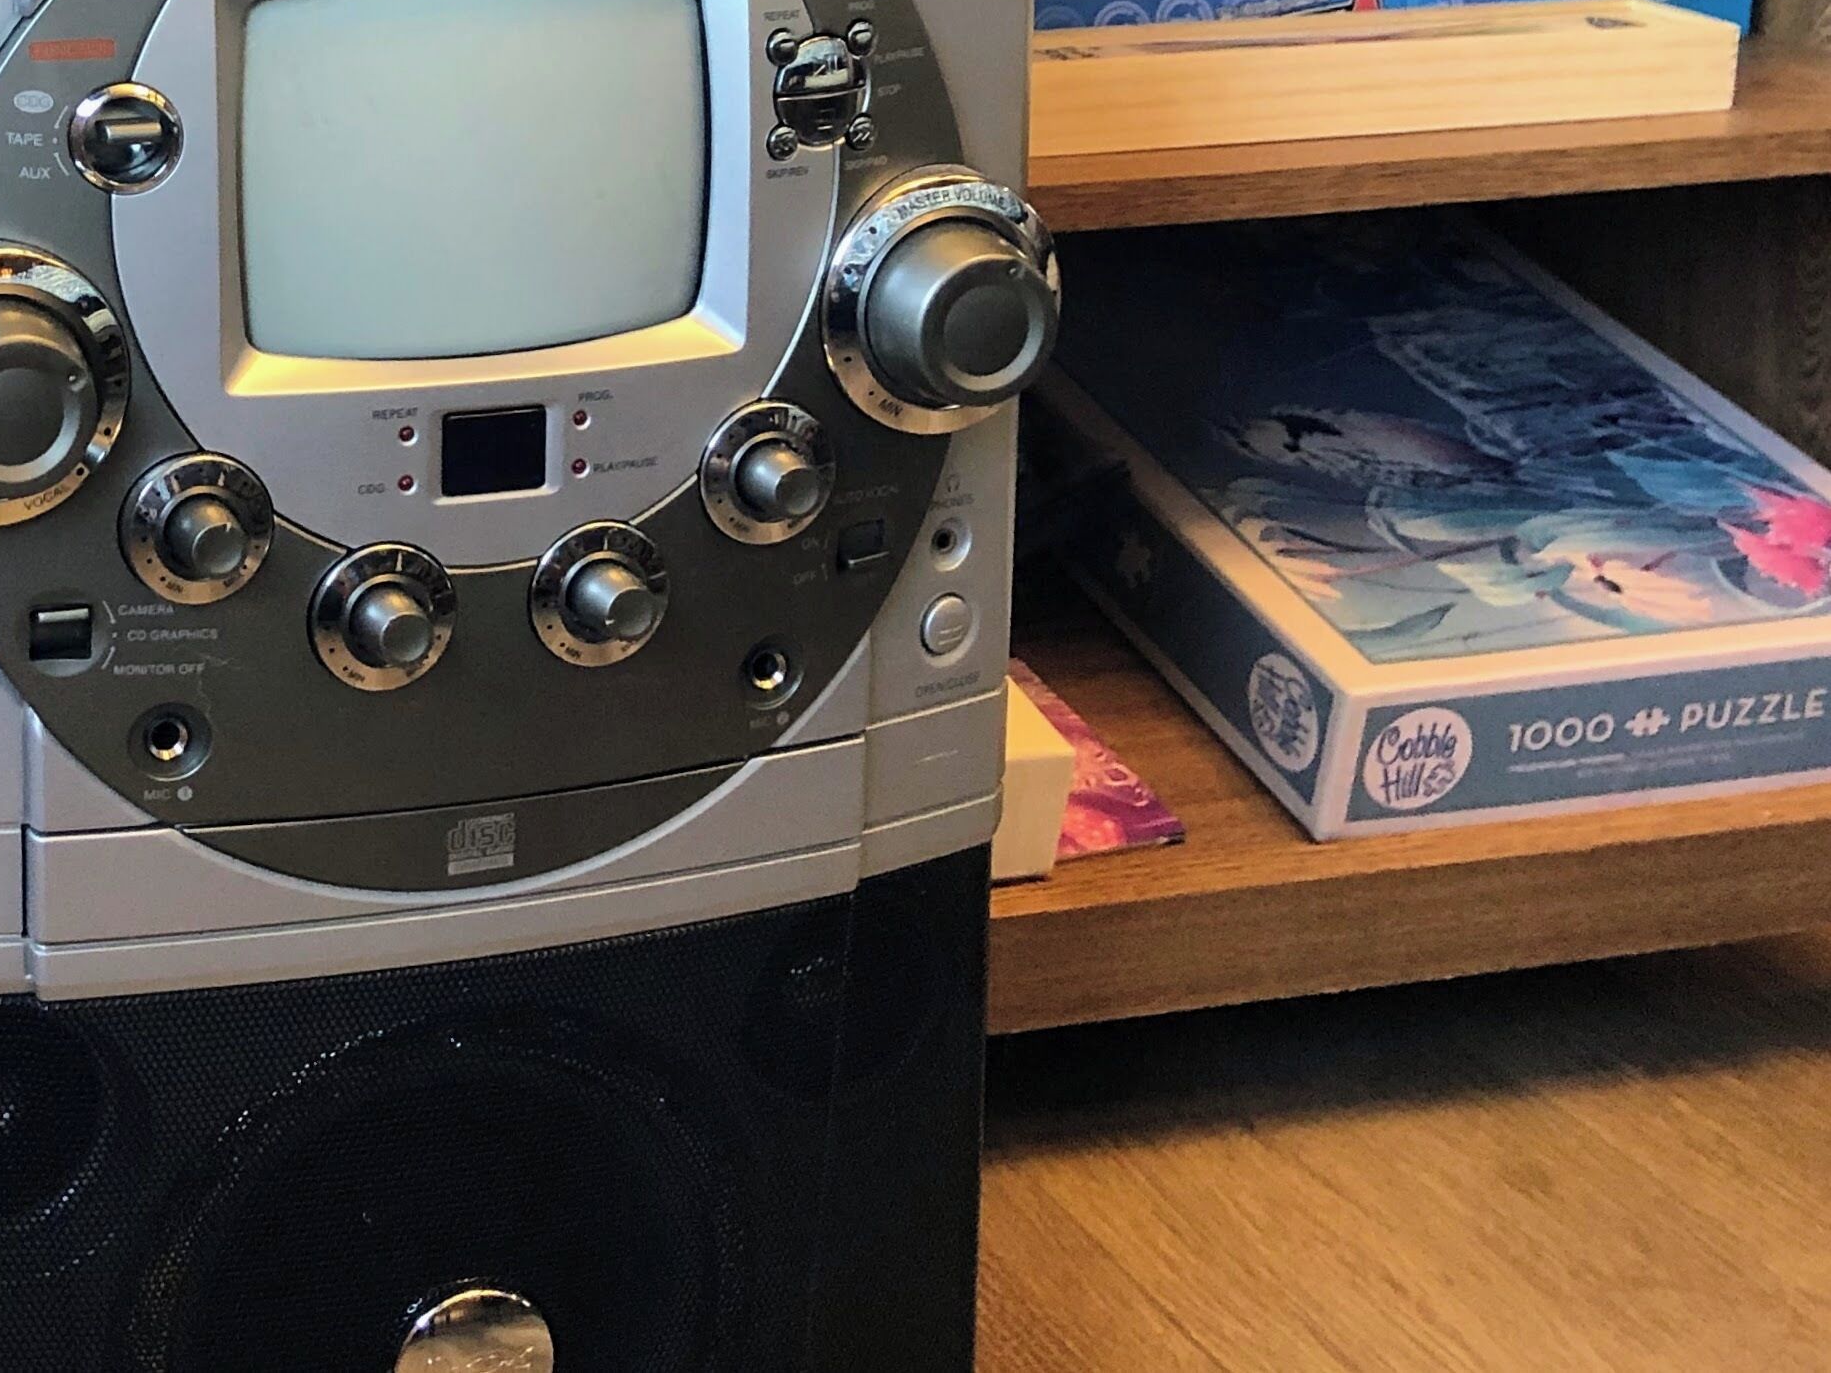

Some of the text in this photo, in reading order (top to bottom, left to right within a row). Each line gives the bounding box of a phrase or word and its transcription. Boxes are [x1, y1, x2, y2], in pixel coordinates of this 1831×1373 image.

[6, 132, 43, 146] TAPE
[19, 166, 50, 179] AUX
[372, 407, 418, 420] REPEAT
[878, 398, 903, 419] MIN
[150, 628, 218, 641] GRAPHICS
[178, 662, 205, 675] OFF
[1509, 688, 1828, 753] 1000 PUZZLE
[1377, 722, 1458, 765] Cobble
[1381, 764, 1425, 804] Hill
